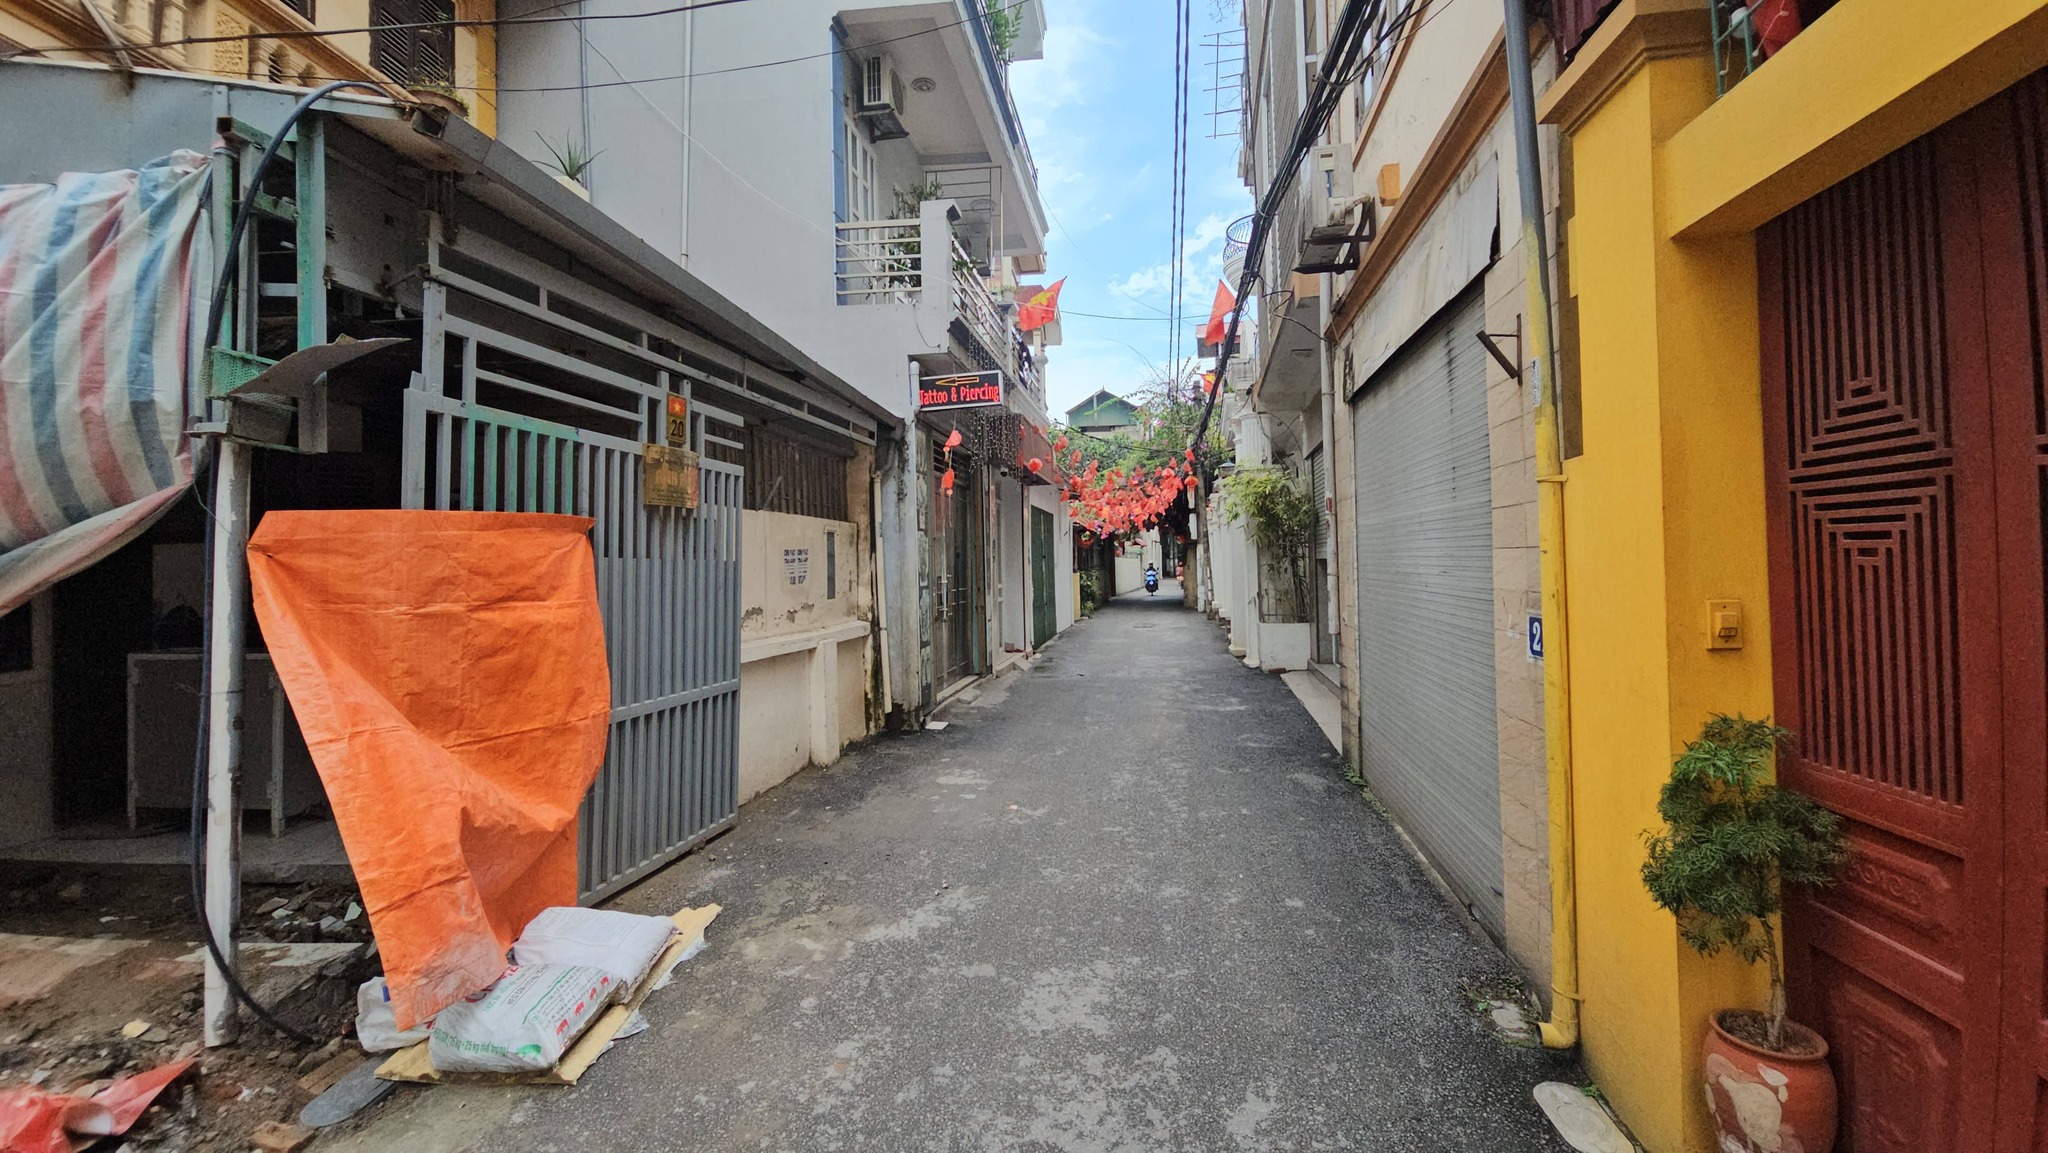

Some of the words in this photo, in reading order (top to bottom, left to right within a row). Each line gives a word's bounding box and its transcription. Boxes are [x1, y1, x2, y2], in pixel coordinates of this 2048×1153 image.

[919, 389, 948, 405] Tattoo
[951, 386, 958, 402] &
[960, 383, 999, 402] Piercing
[670, 419, 684, 437] 20
